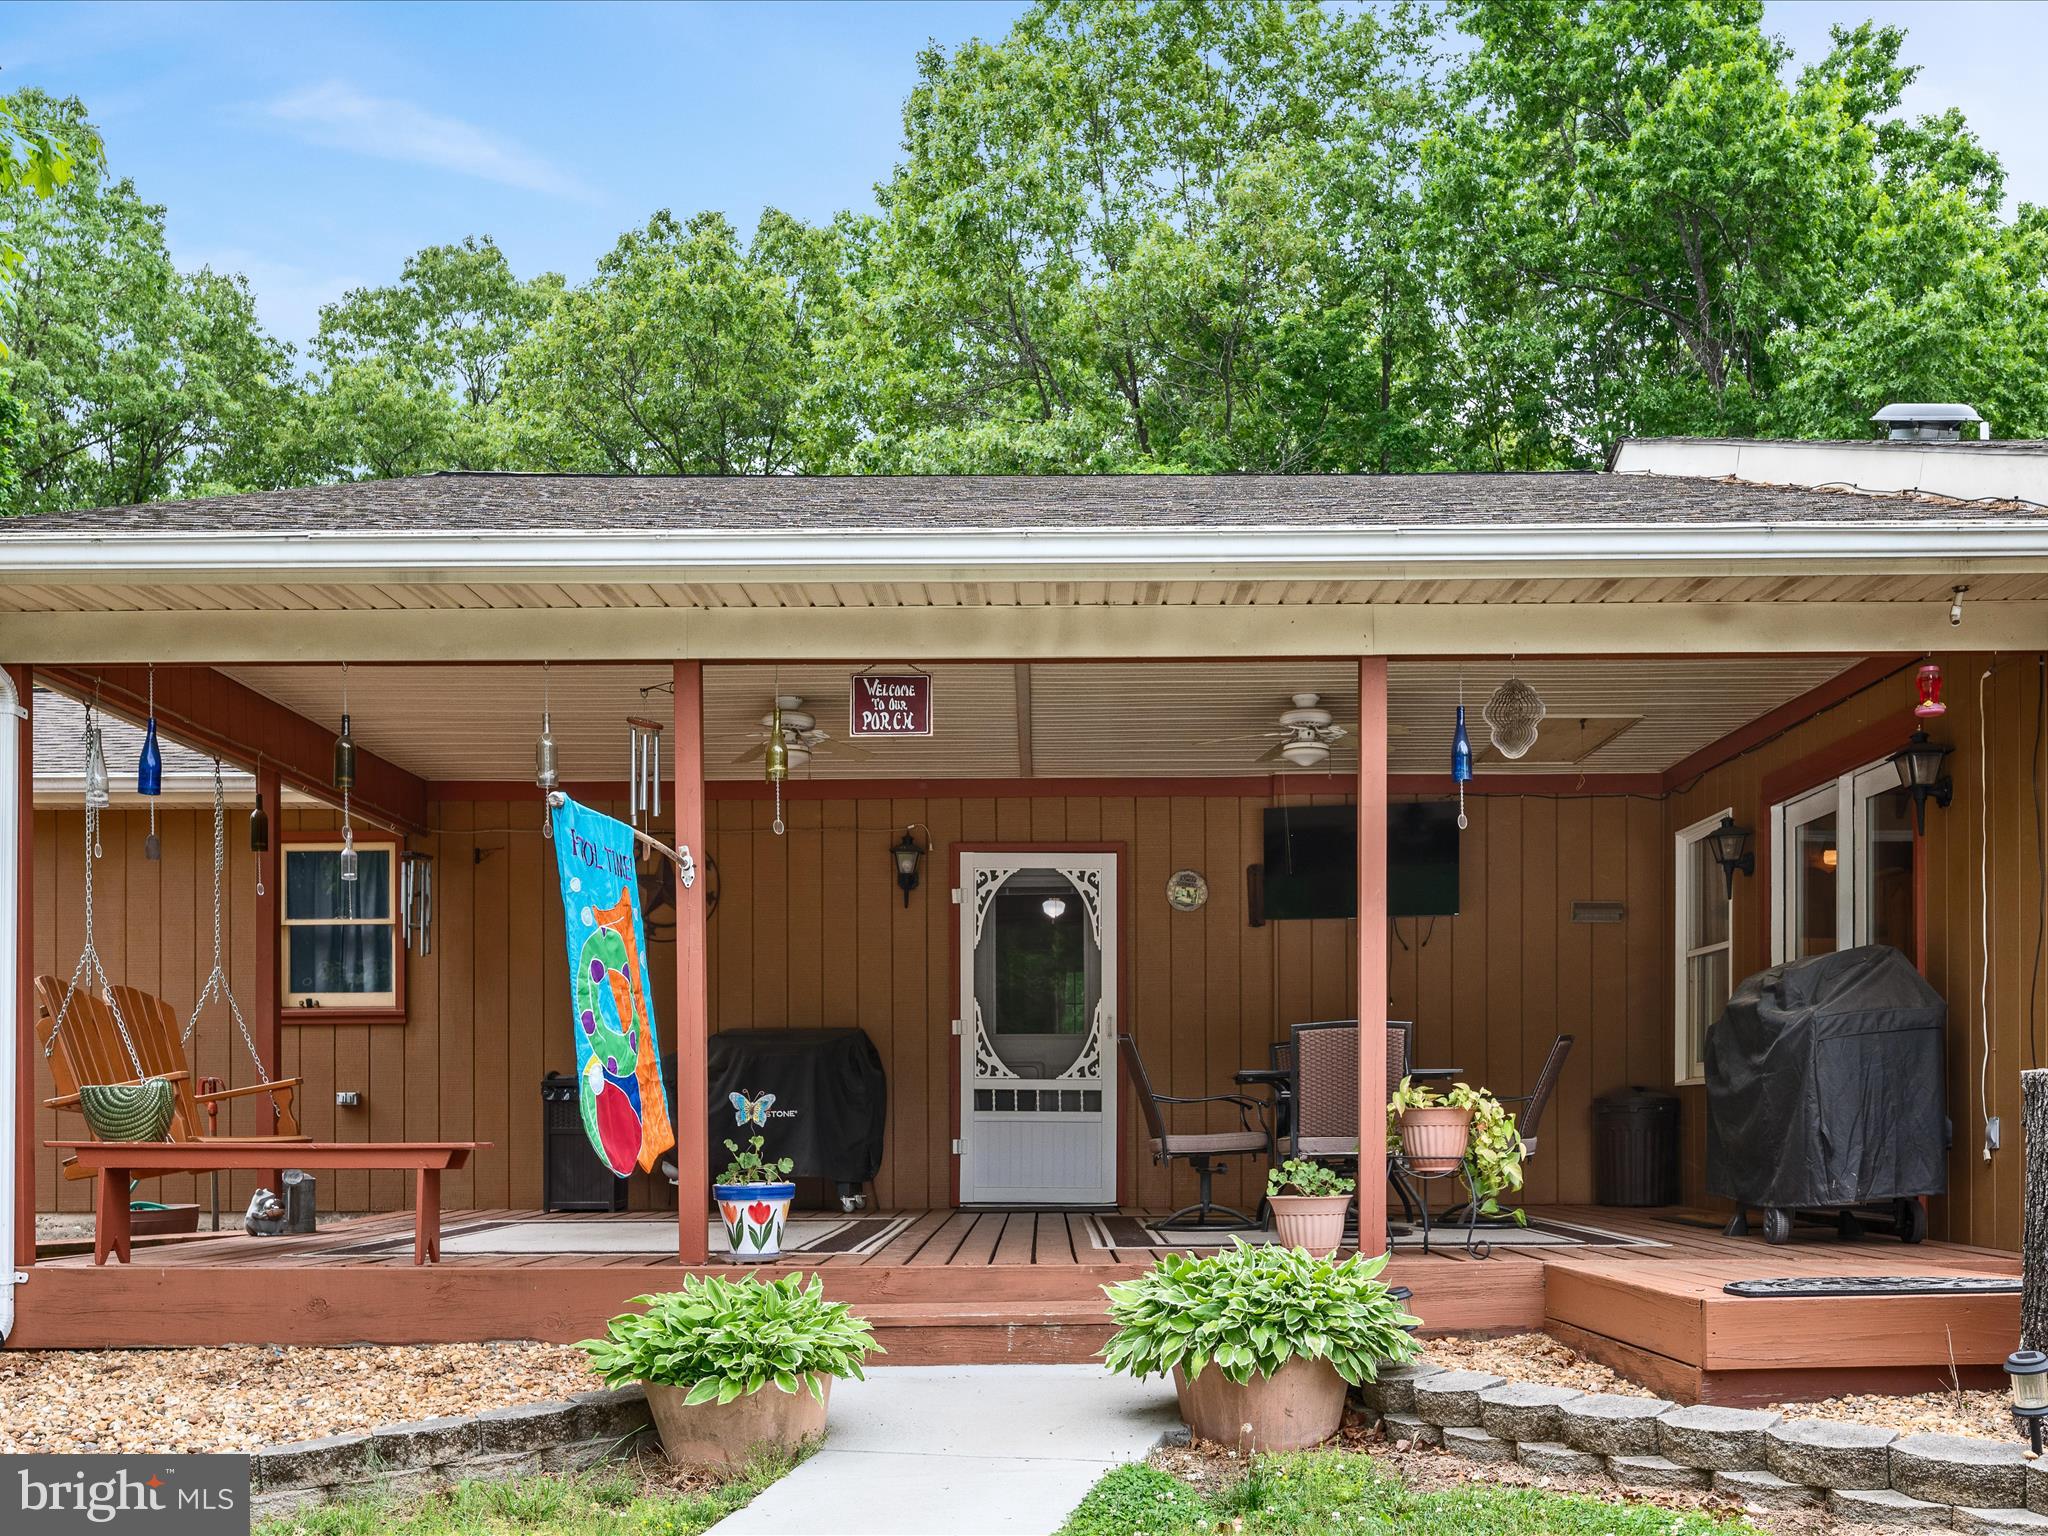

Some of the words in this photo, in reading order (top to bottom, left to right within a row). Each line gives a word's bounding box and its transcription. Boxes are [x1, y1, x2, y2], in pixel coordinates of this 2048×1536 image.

[863, 678, 915, 696] WELCOME
[871, 698, 885, 710] TO
[888, 698, 908, 710] OUR
[862, 711, 915, 730] PORCH
